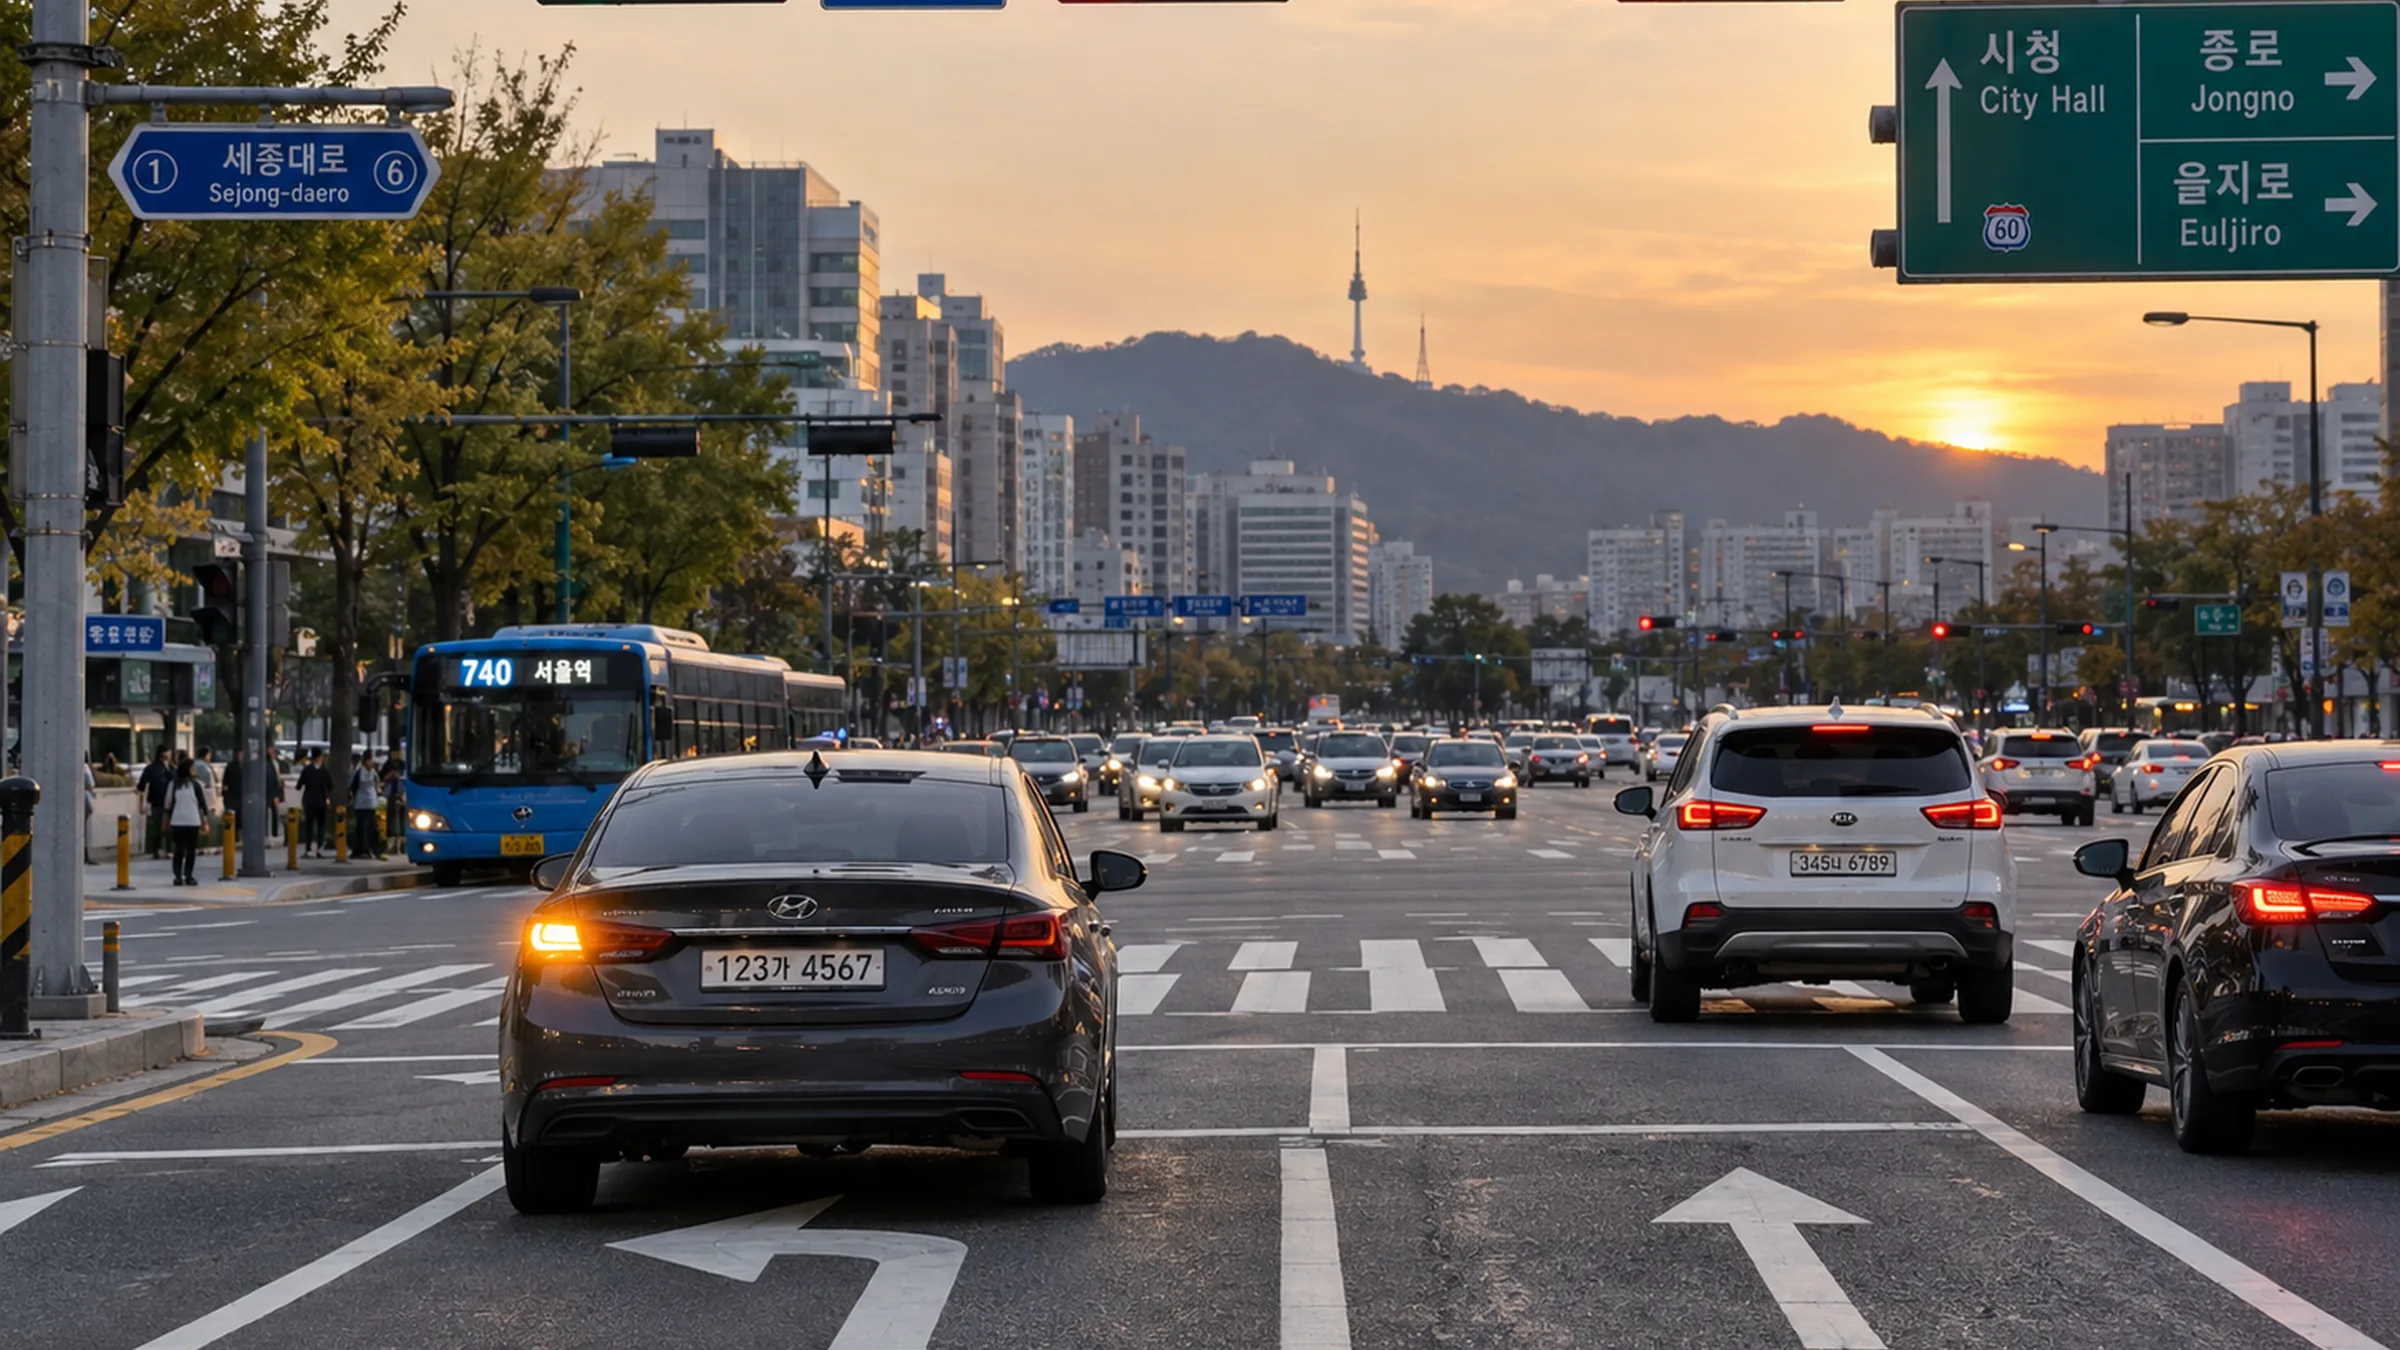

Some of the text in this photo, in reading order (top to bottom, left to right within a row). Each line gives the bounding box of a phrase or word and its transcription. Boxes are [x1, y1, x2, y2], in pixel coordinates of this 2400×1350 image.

[1980, 29, 2060, 74] 시청
[2199, 29, 2283, 72] 종로
[1980, 84, 2106, 121] City Hall
[2191, 84, 2295, 119] Jongno
[148, 158, 160, 185] 1
[222, 142, 348, 176] 세종대로
[386, 159, 405, 186] 6
[209, 182, 349, 208] Sejong-daero
[2173, 160, 2294, 205] 을지로
[1995, 218, 2019, 240] 60
[2181, 217, 2282, 253] Euljiro
[461, 658, 593, 687] 740 서울역
[1847, 854, 1890, 872] 6789
[717, 953, 873, 983] 123가 4567
